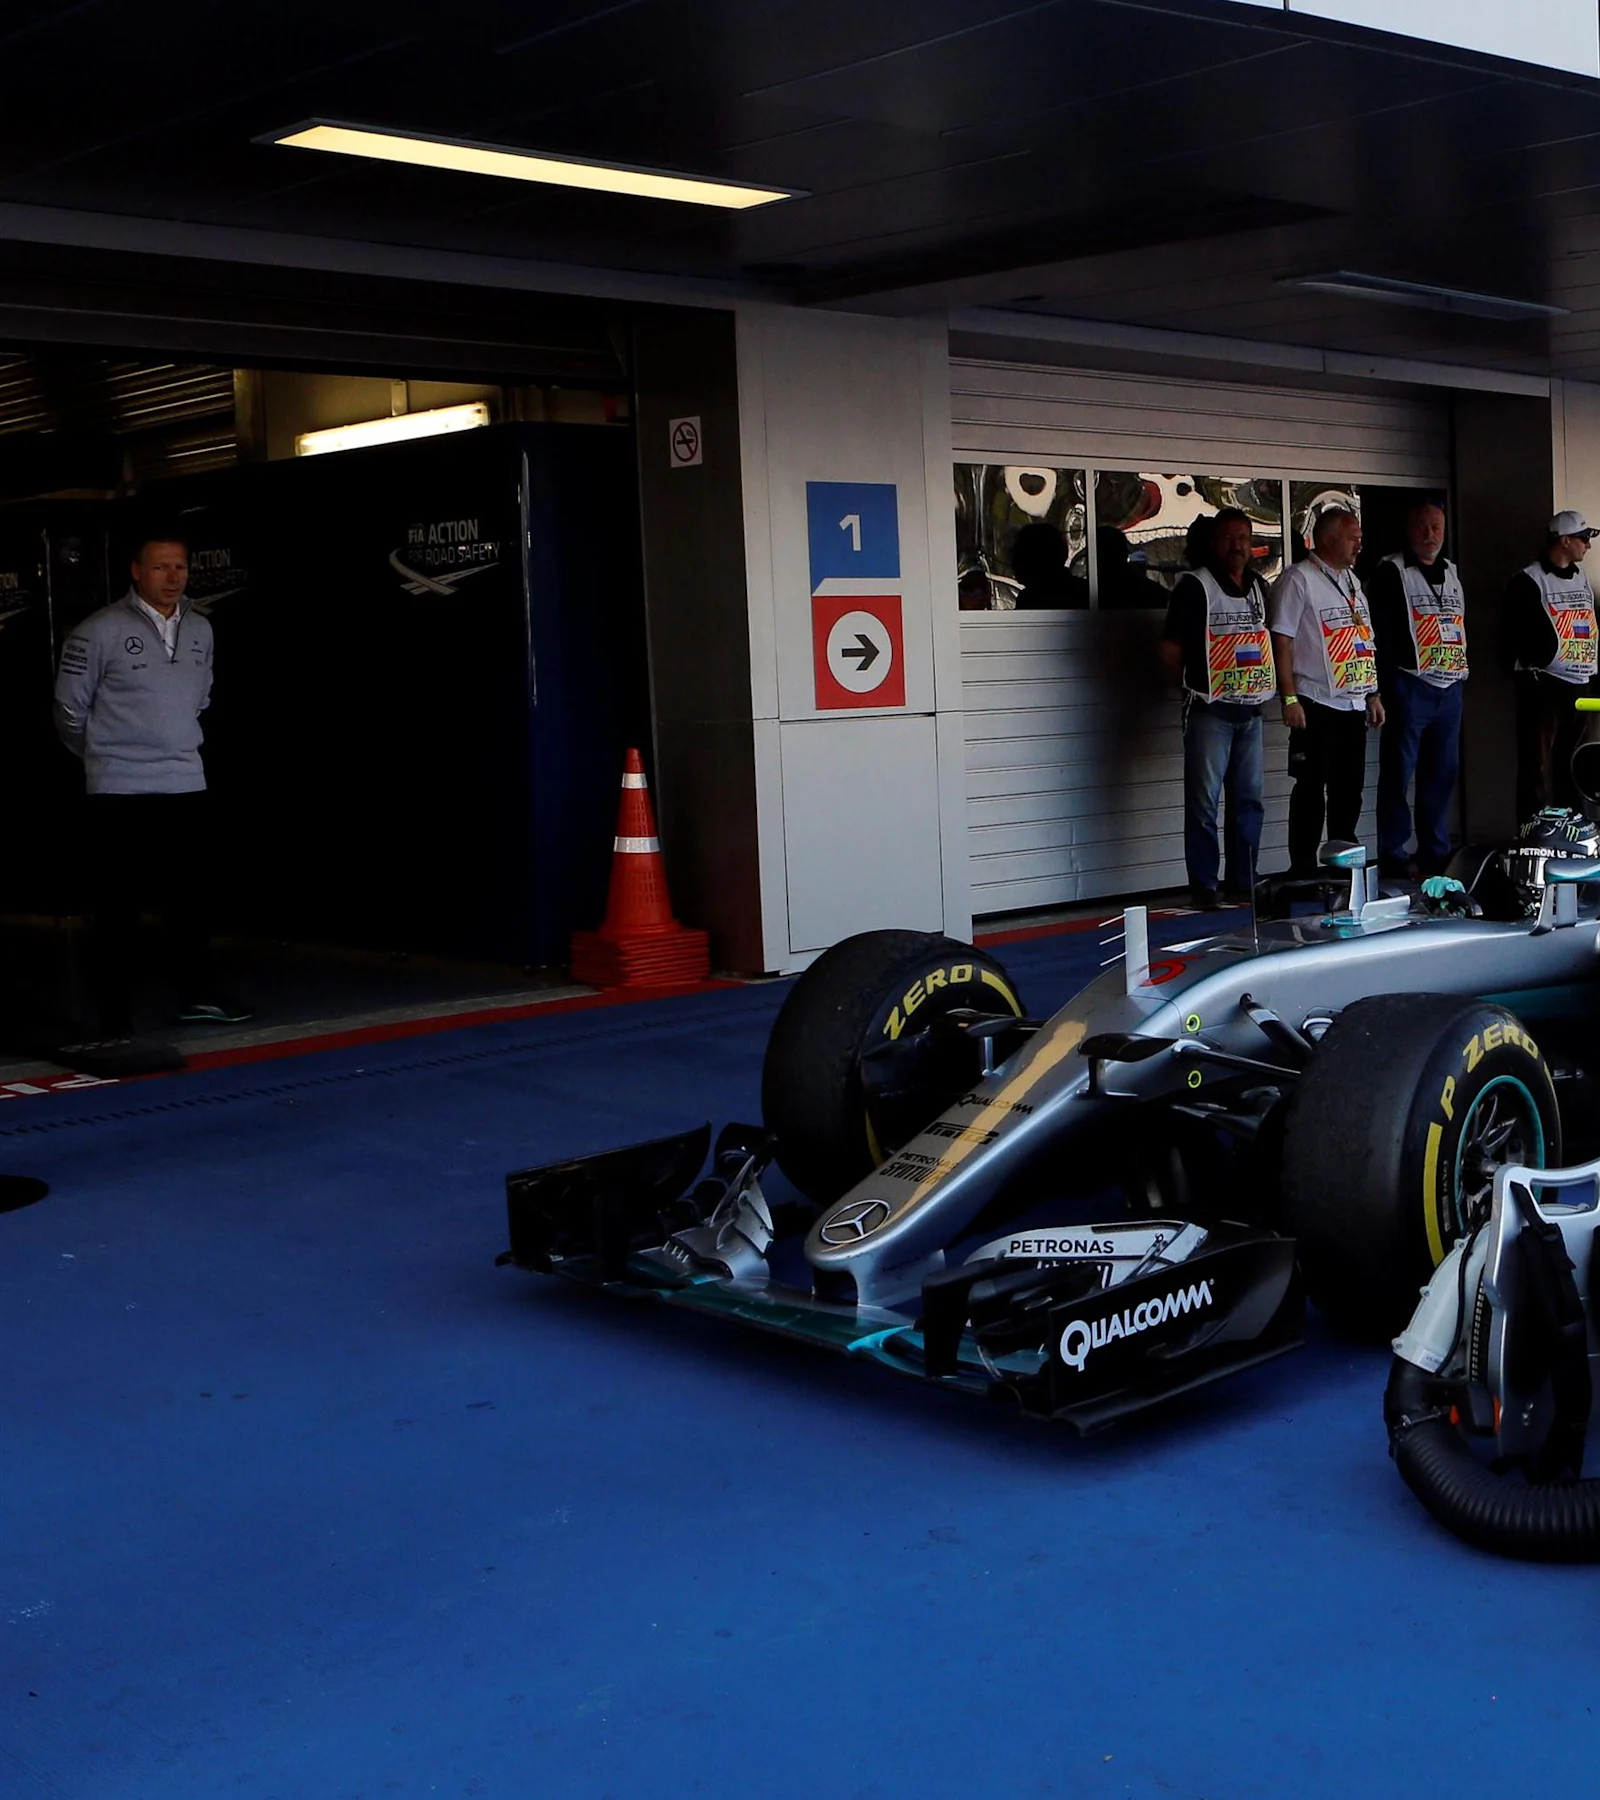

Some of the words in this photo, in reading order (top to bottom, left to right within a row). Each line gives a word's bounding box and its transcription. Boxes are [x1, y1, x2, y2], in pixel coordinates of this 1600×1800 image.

[407, 528, 425, 545] FIA
[427, 518, 479, 545] ACTION
[839, 514, 862, 552] 1
[190, 547, 232, 570] ACTION
[425, 546, 456, 566] ROAD
[457, 541, 501, 563] SAFETY
[1224, 670, 1245, 681] PIT
[1345, 661, 1363, 673] PIT
[1519, 847, 1568, 859] PETRONAS
[882, 963, 973, 1041] ZERO
[1440, 1075, 1457, 1121] P
[1463, 1023, 1540, 1074] ZERO
[956, 1094, 1034, 1115] QUALCOMM
[898, 1152, 960, 1170] PETRONAS
[1010, 1239, 1114, 1255] PETRONAS
[1060, 1279, 1214, 1373] QUALCOMM
